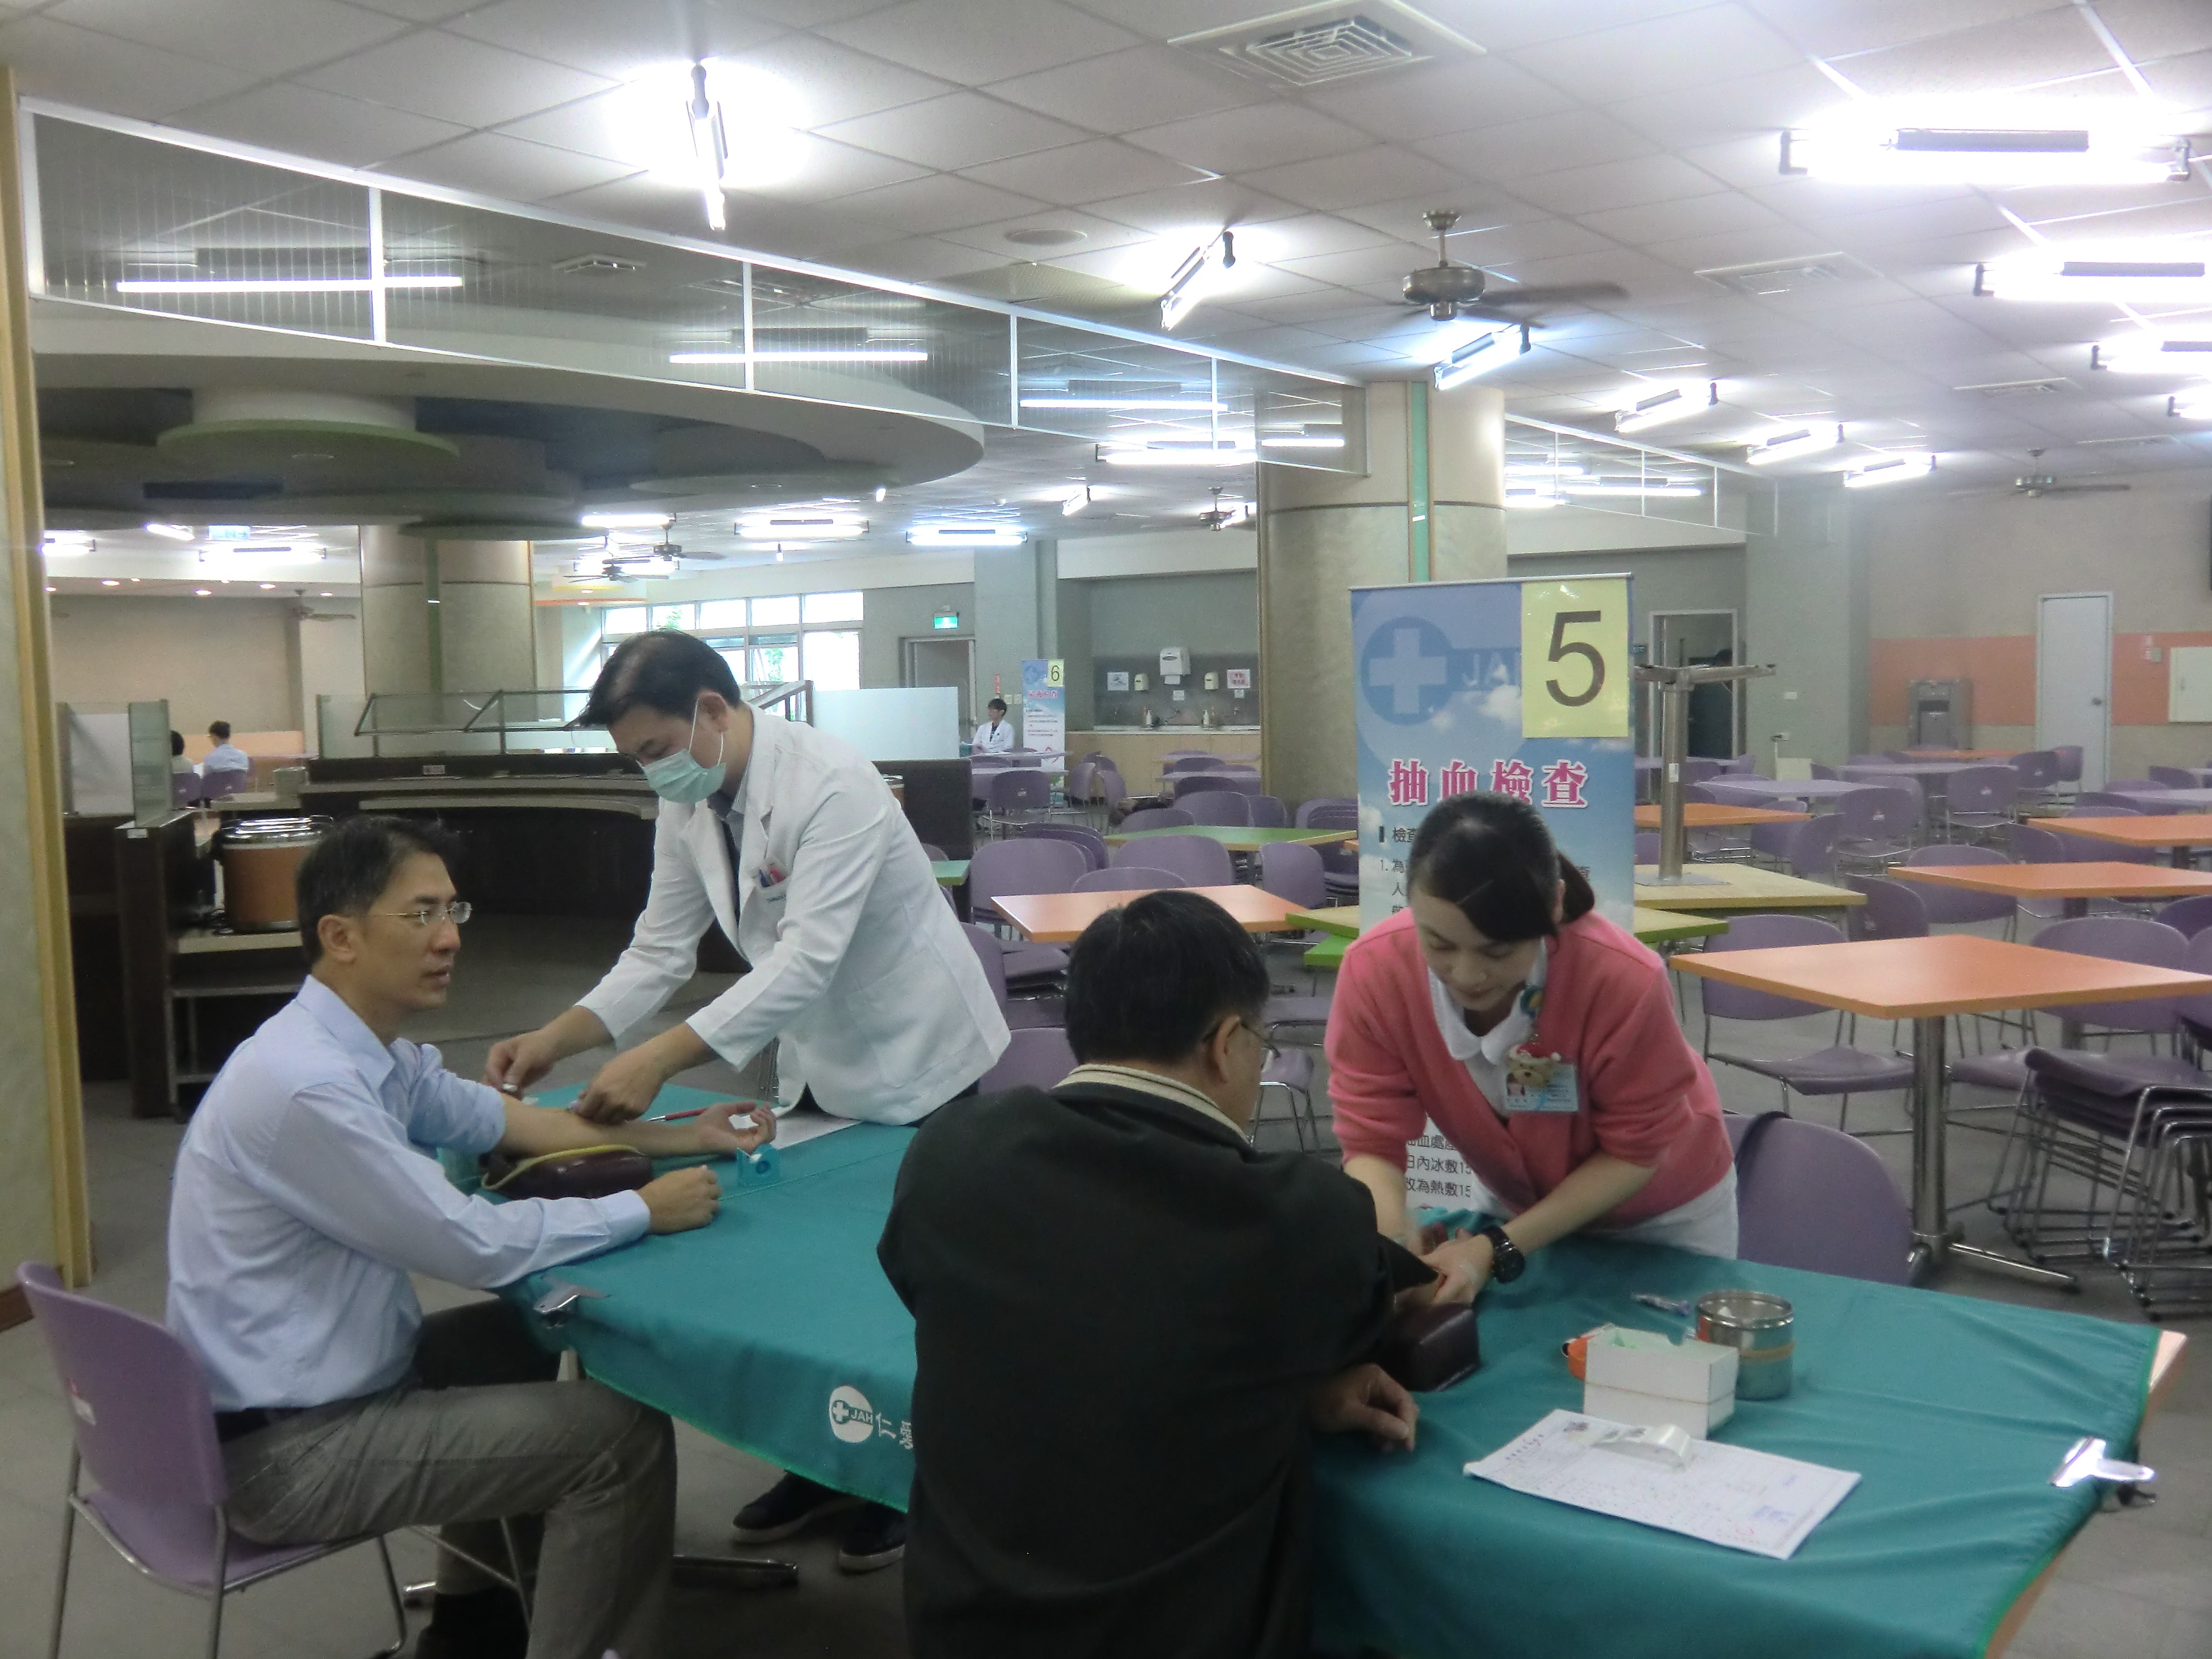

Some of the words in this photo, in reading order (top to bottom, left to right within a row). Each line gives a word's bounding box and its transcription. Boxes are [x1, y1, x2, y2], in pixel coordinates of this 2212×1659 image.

[1545, 610, 1605, 707] 5
[1051, 665, 1060, 682] 6
[1388, 758, 1589, 808] 抽血檢查
[1392, 859, 1407, 873] 為
[851, 1409, 873, 1423] JAH
